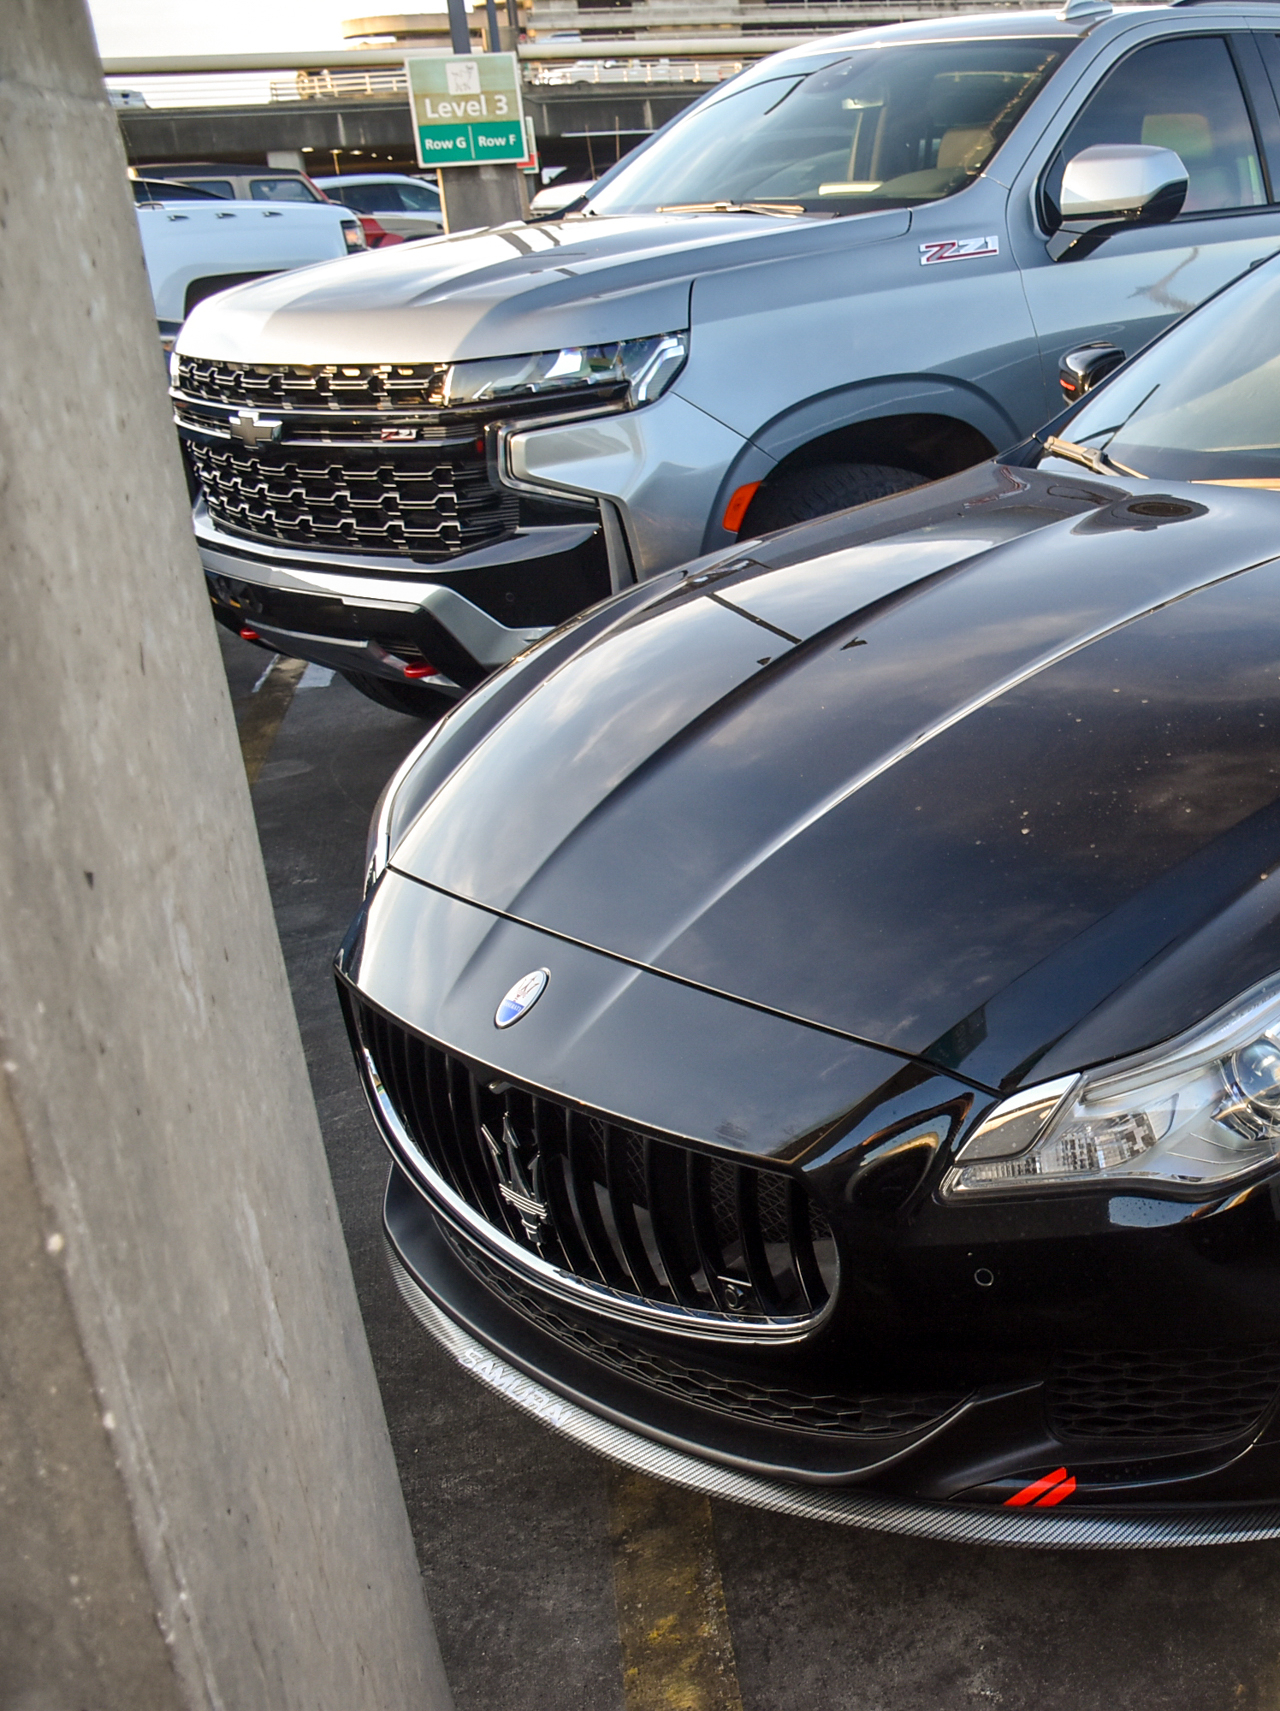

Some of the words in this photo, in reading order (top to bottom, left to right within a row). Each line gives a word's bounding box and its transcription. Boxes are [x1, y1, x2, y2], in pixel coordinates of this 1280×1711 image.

[424, 94, 488, 119] Level
[493, 94, 509, 116] 3
[424, 137, 454, 151] Row
[455, 136, 467, 149] G
[477, 135, 507, 148] Row
[508, 133, 517, 146] F
[918, 235, 999, 266] Z71
[457, 1348, 573, 1428] SAMURAI
